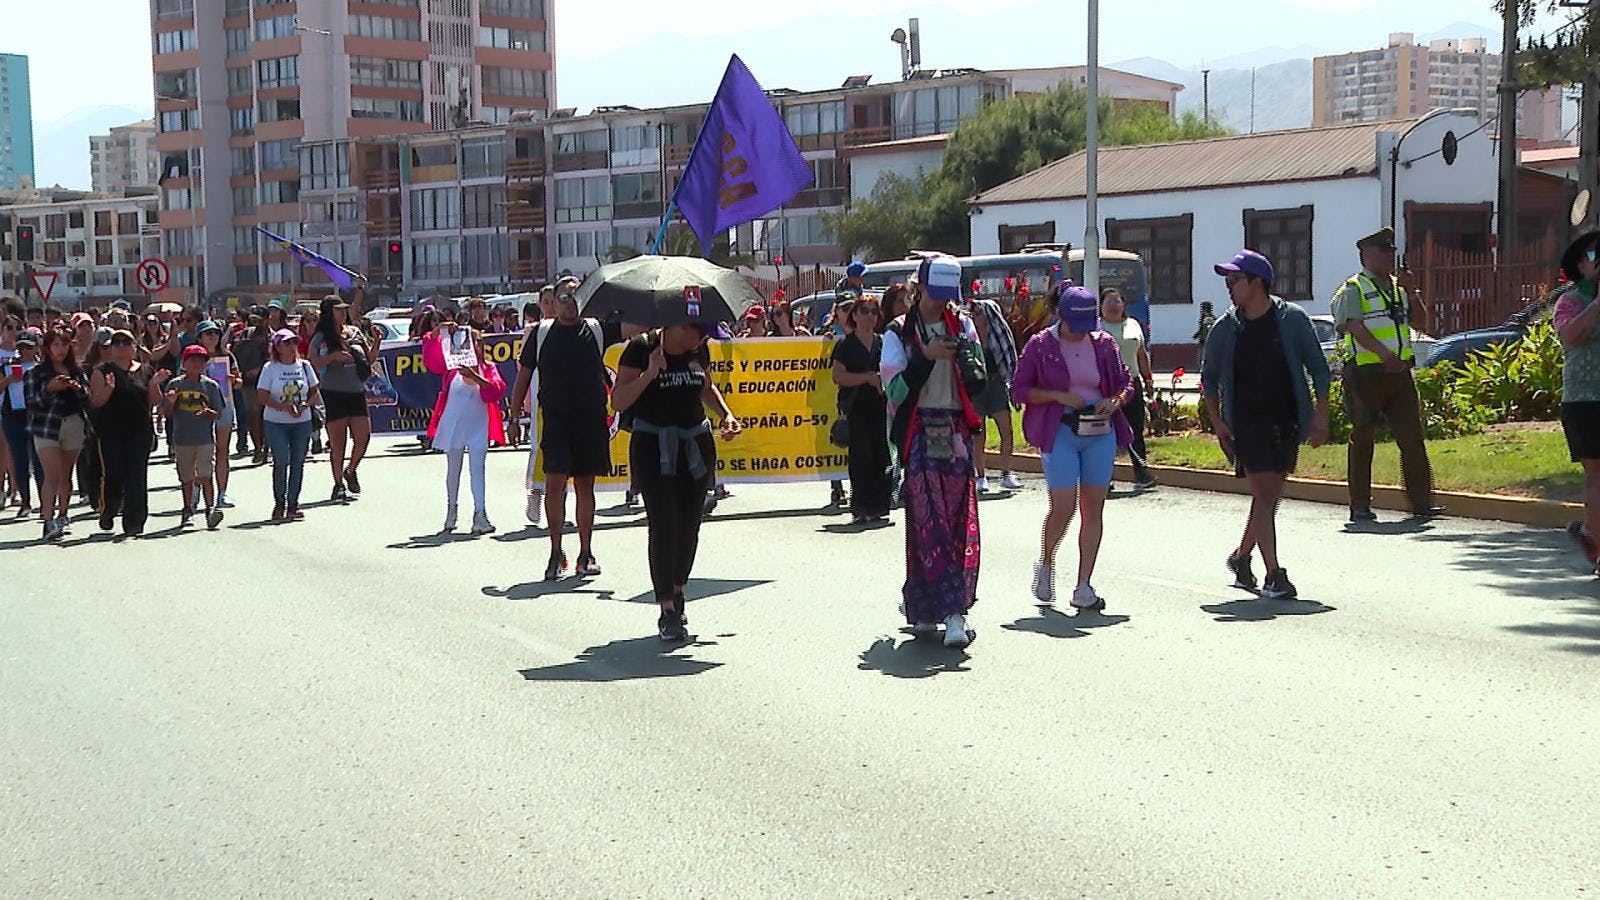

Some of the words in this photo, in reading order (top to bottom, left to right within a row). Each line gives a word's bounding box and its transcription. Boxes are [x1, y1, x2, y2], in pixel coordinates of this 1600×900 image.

[740, 361, 749, 372] Y
[738, 377, 816, 394] EDUCACIÓN
[735, 413, 788, 429] SPAÑA
[793, 414, 828, 427] D-59
[730, 459, 746, 471] SE
[751, 457, 790, 470] HAGA
